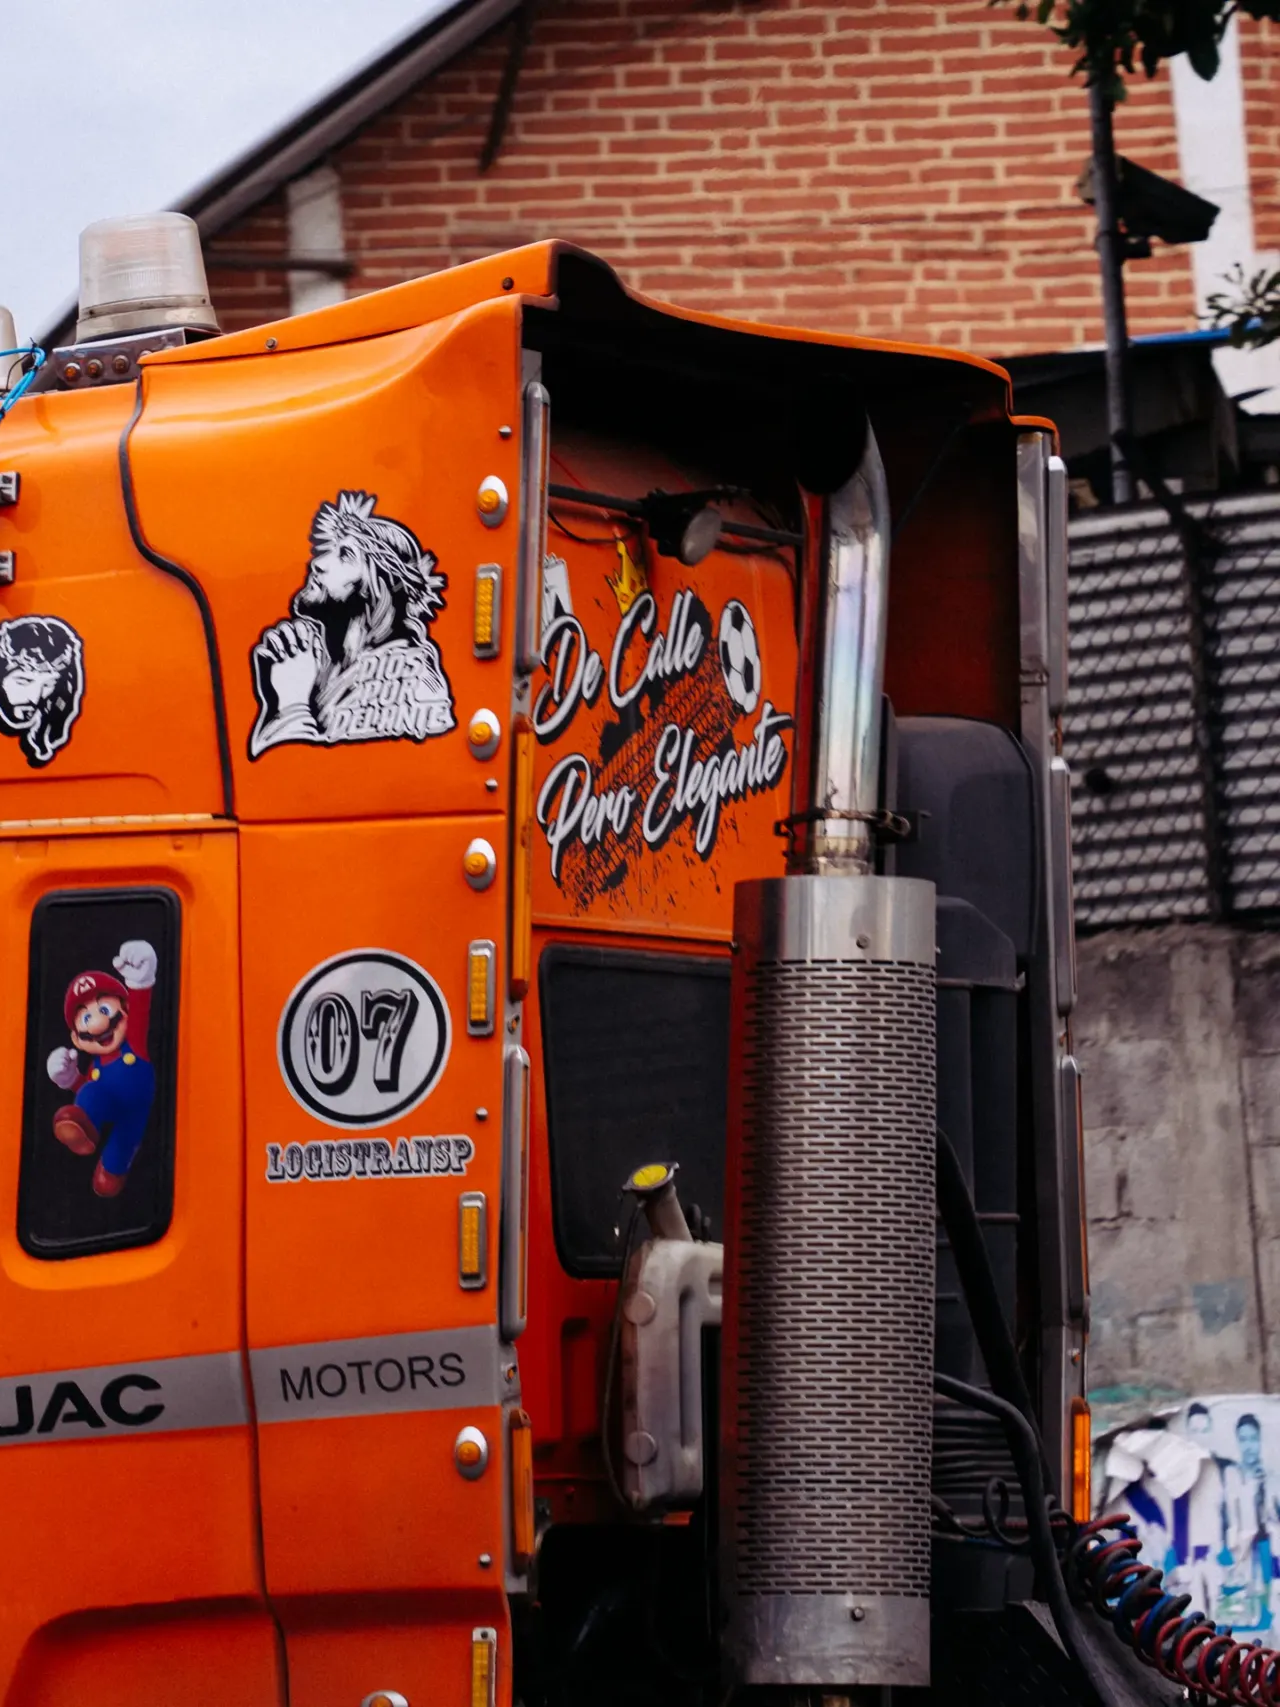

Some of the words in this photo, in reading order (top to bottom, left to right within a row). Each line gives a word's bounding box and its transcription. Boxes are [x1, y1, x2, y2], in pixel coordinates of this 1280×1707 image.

[534, 614, 604, 735] De
[610, 589, 705, 708] Calle
[536, 752, 636, 880] Pero
[642, 700, 793, 854] Elegante
[304, 988, 420, 1097] 07
[267, 1137, 472, 1180] LOGISTRANSP
[280, 1352, 466, 1402] MOTORS
